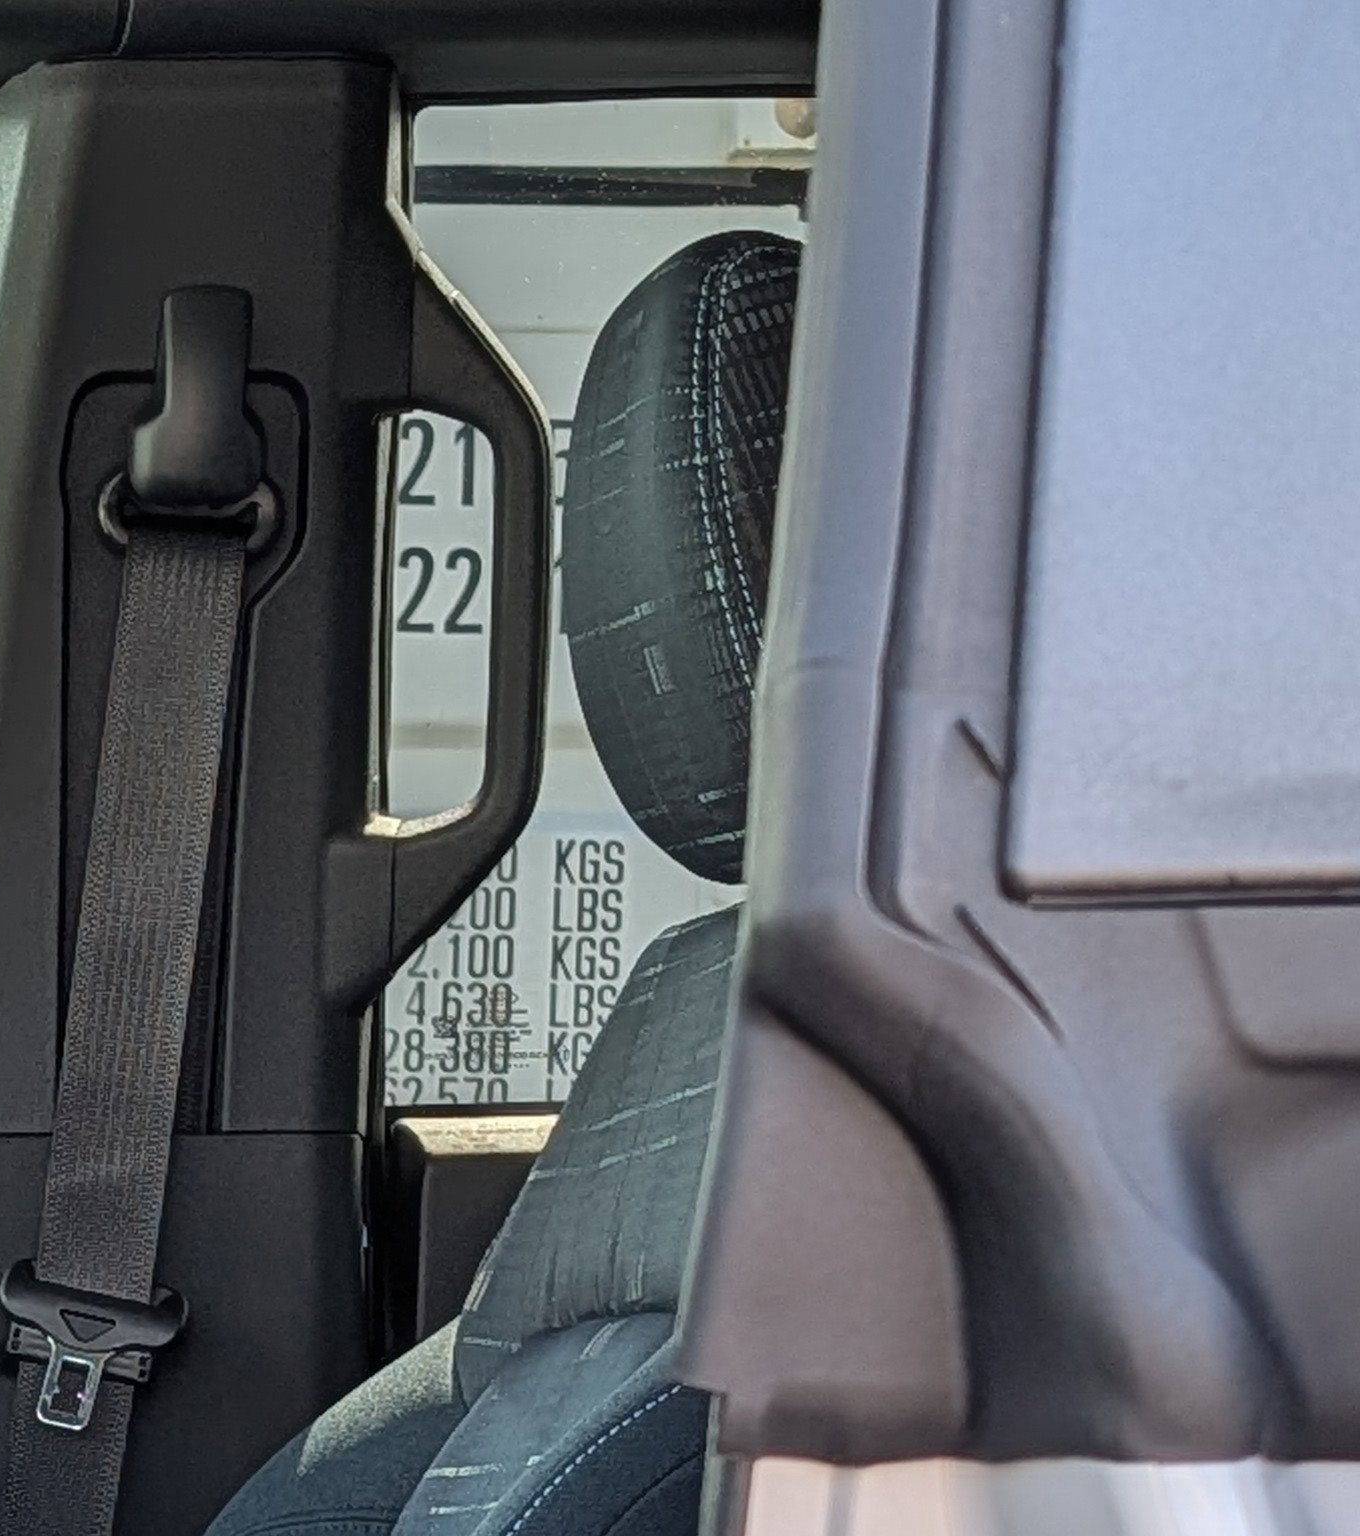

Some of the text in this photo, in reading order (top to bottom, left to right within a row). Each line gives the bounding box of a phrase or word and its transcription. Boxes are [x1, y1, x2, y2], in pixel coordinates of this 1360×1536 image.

[554, 839, 627, 886] KGS
[552, 887, 624, 933] LBS
[550, 935, 622, 981] KGS
[546, 1030, 593, 1076] KG
